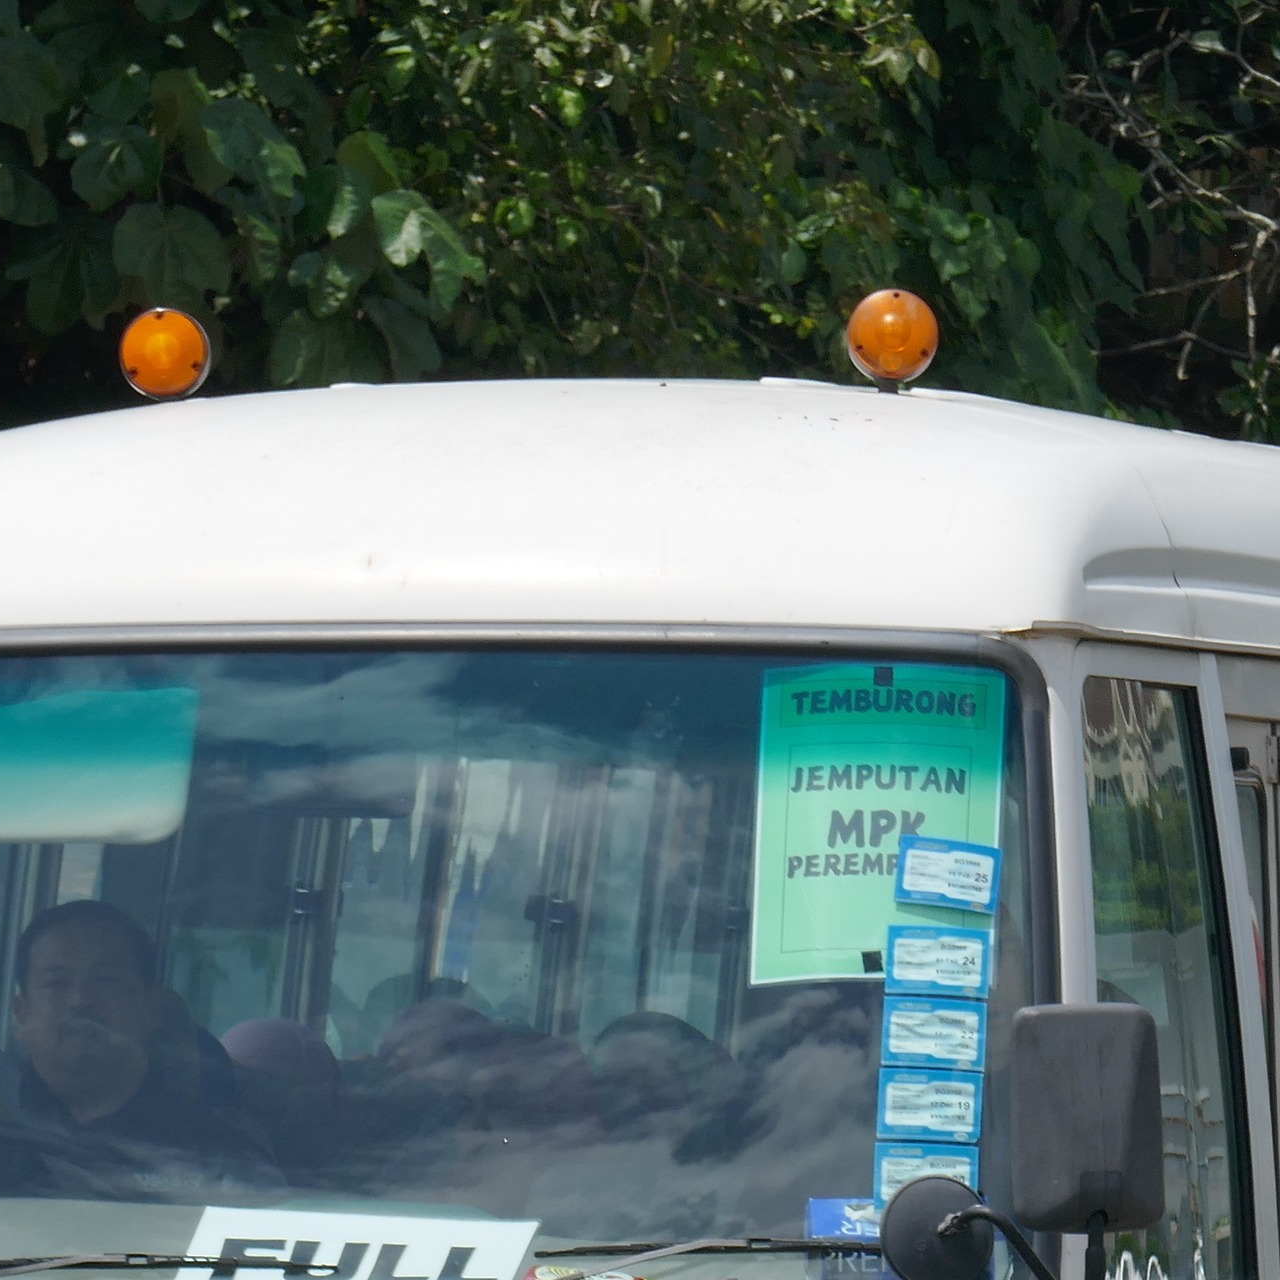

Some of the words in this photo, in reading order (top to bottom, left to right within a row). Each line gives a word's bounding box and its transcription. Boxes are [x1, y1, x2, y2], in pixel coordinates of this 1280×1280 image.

[791, 688, 978, 719] TEMBURONG
[790, 764, 967, 796] JEMPUTAN
[826, 808, 927, 848] MPK
